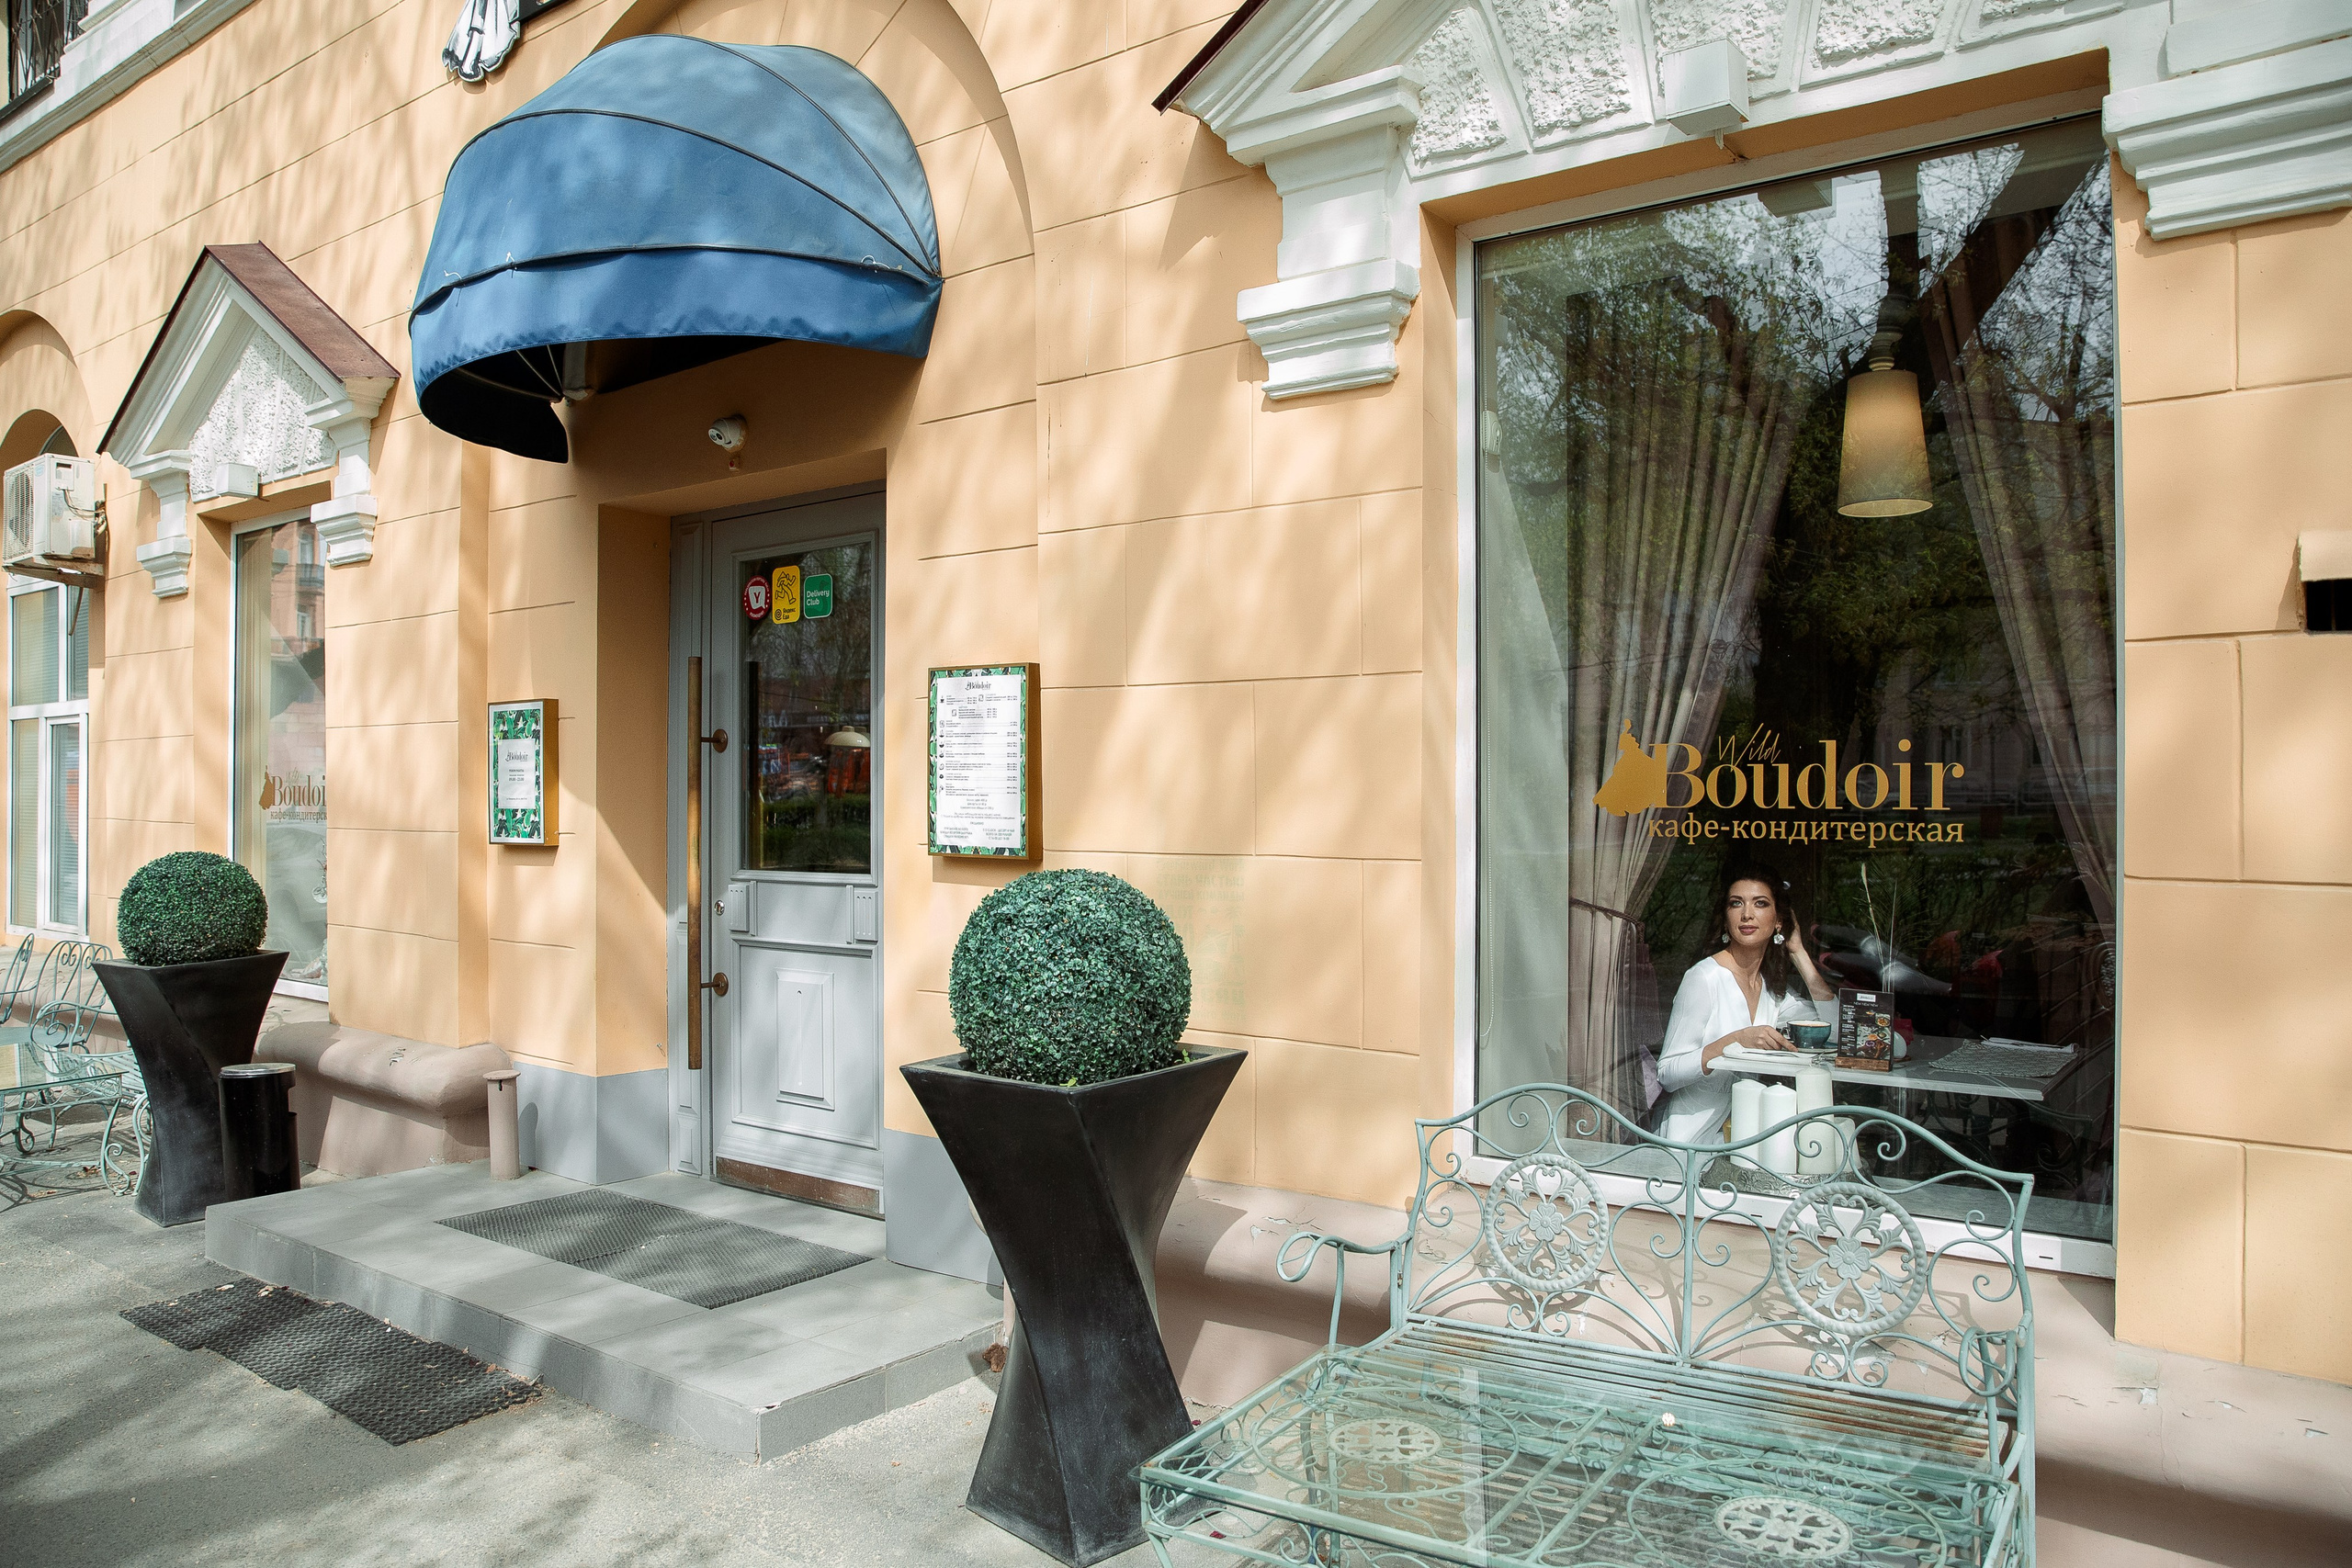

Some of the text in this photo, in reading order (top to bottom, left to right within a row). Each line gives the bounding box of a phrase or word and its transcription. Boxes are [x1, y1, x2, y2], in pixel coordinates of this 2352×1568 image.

[806, 589, 831, 598] Delivery
[806, 598, 820, 606] Club
[968, 681, 991, 690] Boudoir
[1718, 722, 1781, 773] Wild
[1649, 739, 1965, 811] Boudoir
[1648, 813, 1964, 849] кафе-кондитерская
